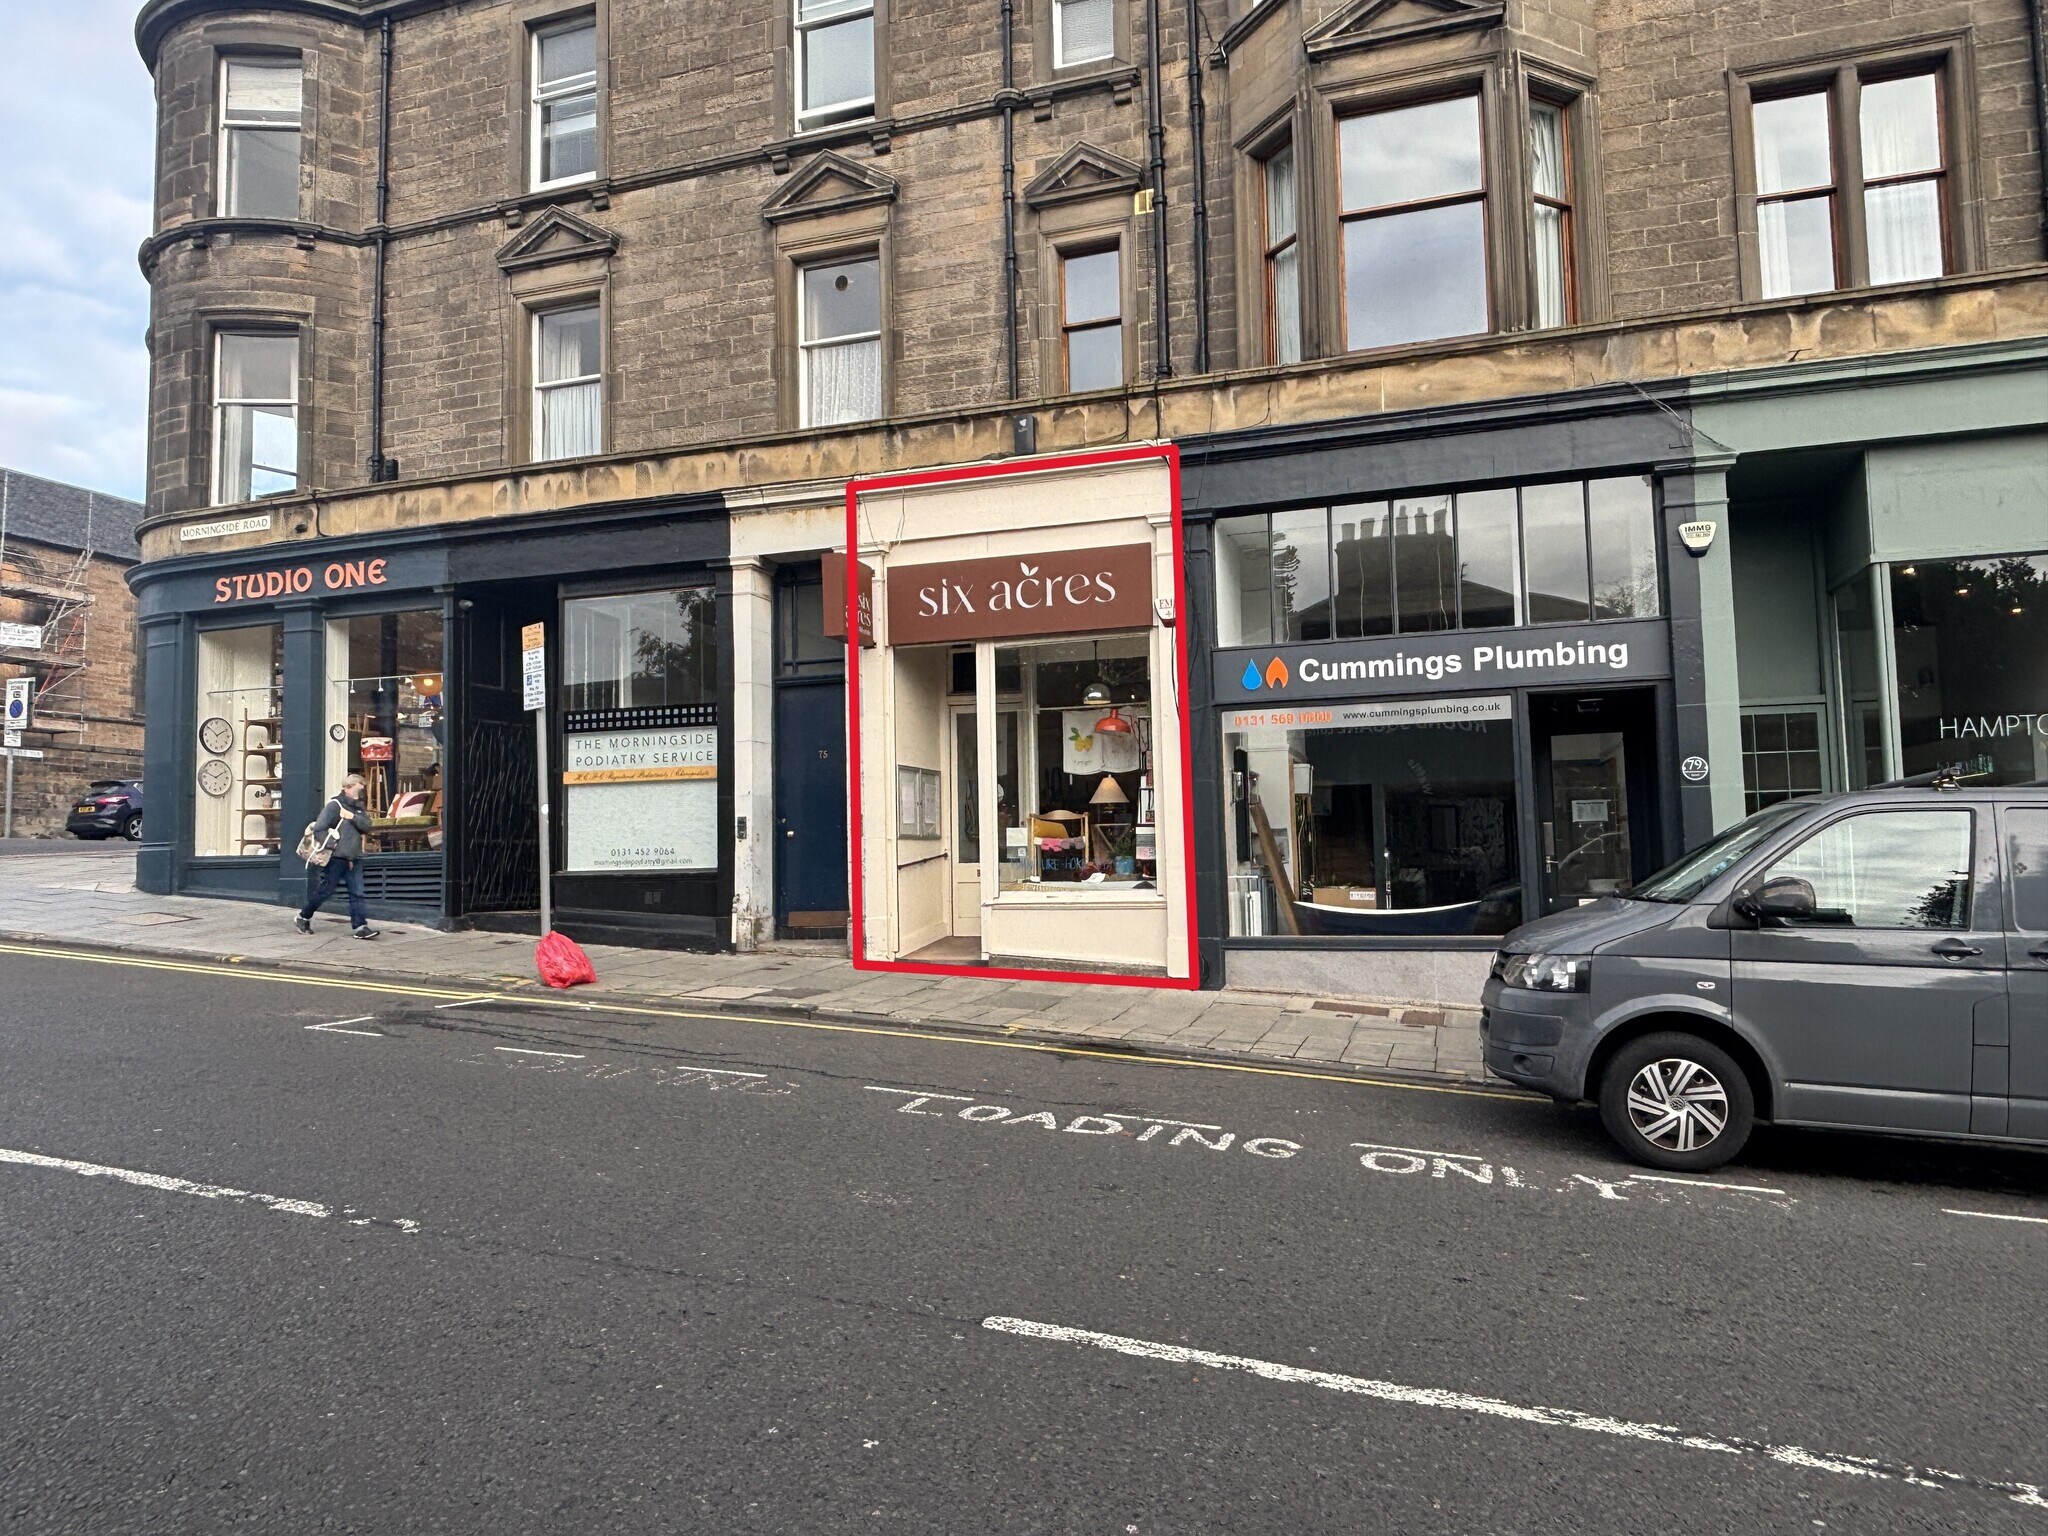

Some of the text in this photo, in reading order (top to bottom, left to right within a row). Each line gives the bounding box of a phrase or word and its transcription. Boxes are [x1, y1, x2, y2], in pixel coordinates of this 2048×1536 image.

[182, 518, 268, 538] MORNINGSIDE ROAD
[215, 559, 387, 603] STUDIO ONE
[918, 570, 1116, 617] six acres
[1299, 641, 1629, 683] Cummings Plumbing
[1343, 702, 1501, 719] www.cummingsplumbing.co.uk
[575, 733, 715, 750] THE MORNINGSIDE
[576, 750, 713, 767] PODIATRY SERVICE
[818, 750, 828, 759] 75
[1687, 759, 1703, 770] 79
[611, 848, 631, 857] 0131
[896, 1098, 1304, 1159] LOADING
